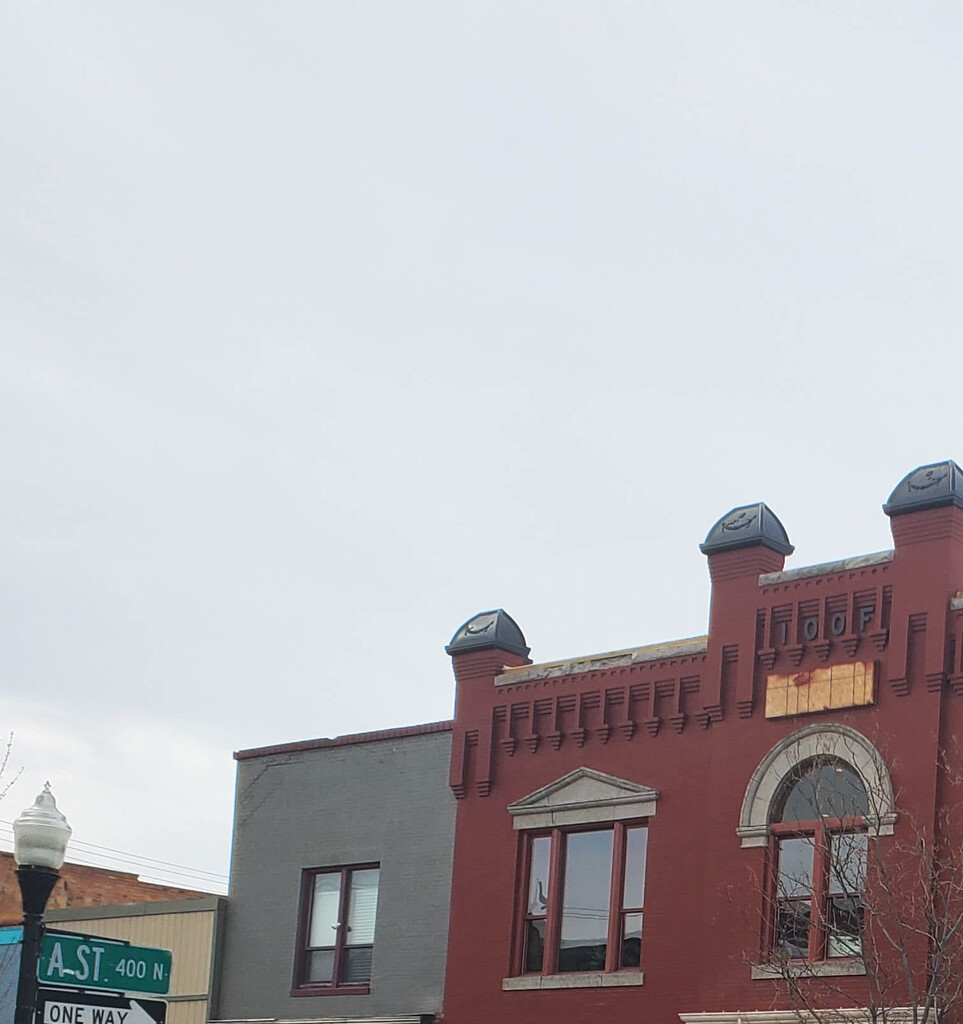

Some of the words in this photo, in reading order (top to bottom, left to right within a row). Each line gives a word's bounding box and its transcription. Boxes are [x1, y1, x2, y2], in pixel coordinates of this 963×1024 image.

[47, 942, 64, 977] A
[115, 959, 146, 979] 400
[50, 1005, 84, 1024] ONE
